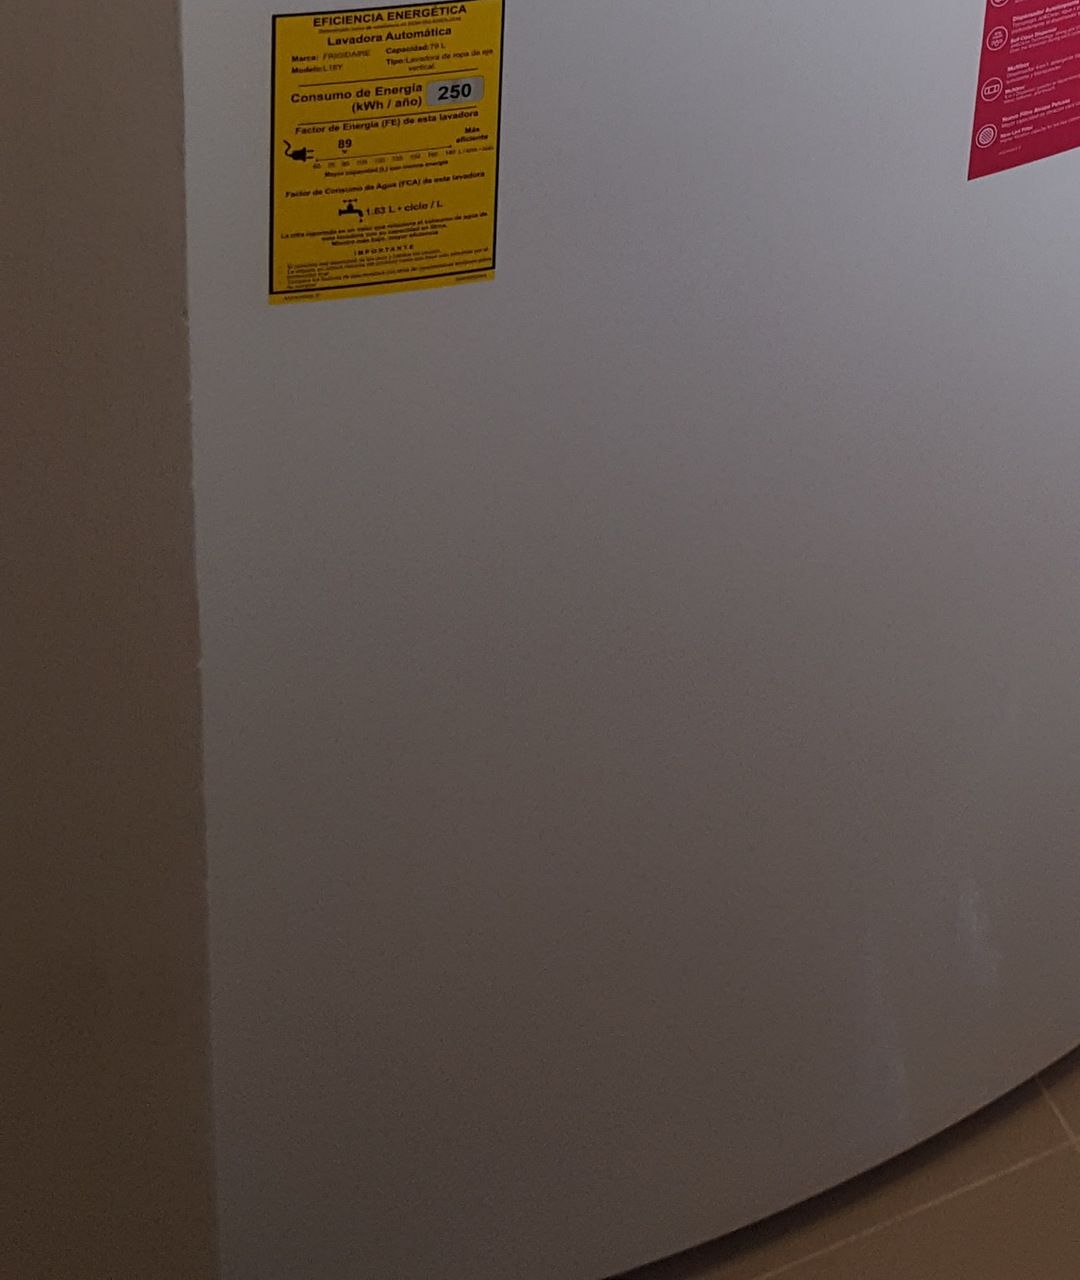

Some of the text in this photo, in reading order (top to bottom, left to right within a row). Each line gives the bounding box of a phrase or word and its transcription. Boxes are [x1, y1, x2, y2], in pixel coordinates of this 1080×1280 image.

[312, 12, 384, 28] EFICIENCIA
[387, 4, 467, 22] ENERGÉTICA
[327, 26, 452, 47] Lavadora Automática
[290, 82, 472, 105] Consumo de Energía 250
[351, 99, 384, 114] (kWh
[394, 94, 423, 109] año)
[295, 109, 479, 135] Factor de Energía (FE) de esta lavadora
[337, 138, 353, 150] 89
